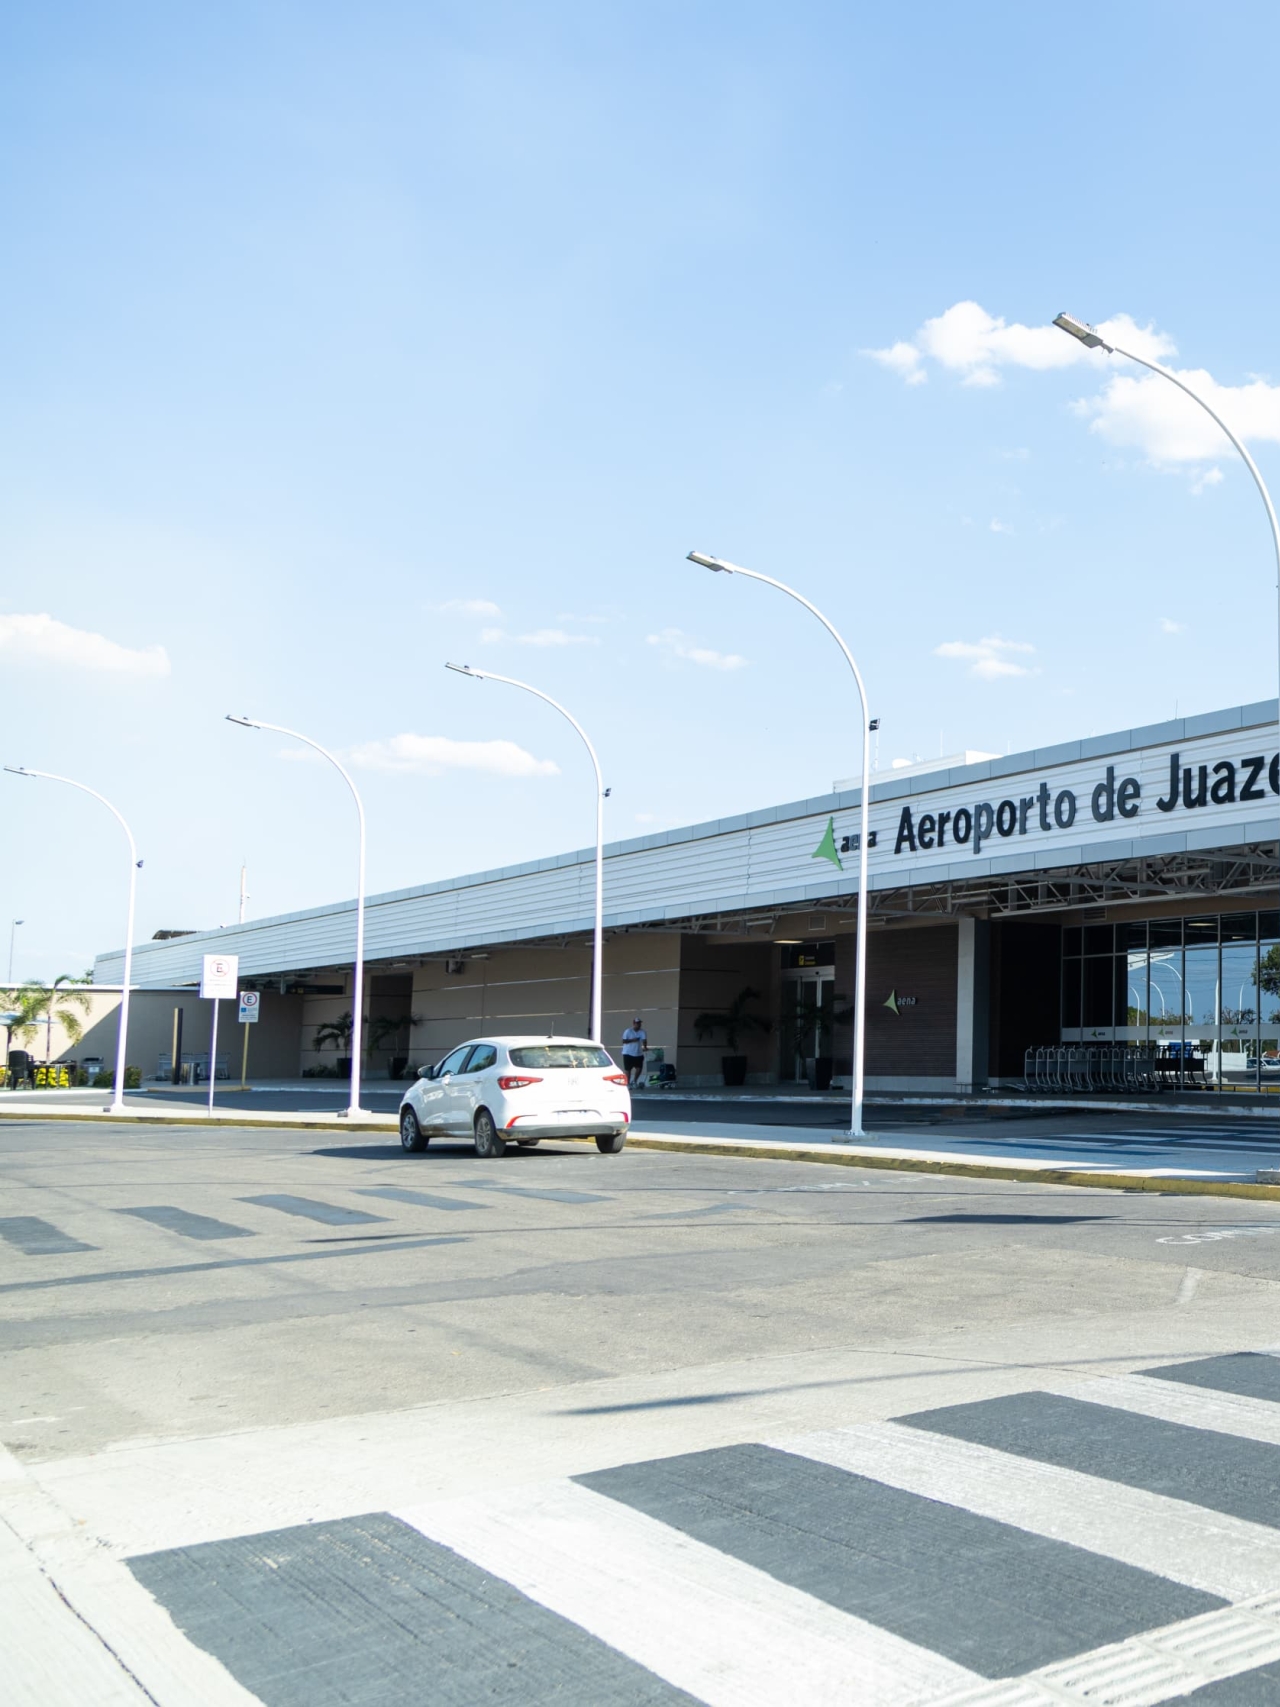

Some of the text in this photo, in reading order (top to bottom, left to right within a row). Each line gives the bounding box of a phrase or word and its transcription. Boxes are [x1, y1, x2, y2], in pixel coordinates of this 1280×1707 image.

[894, 782, 1077, 854] Aeroporto
[1091, 766, 1141, 823] de
[841, 831, 877, 853] aea
[897, 996, 916, 1006] aena
